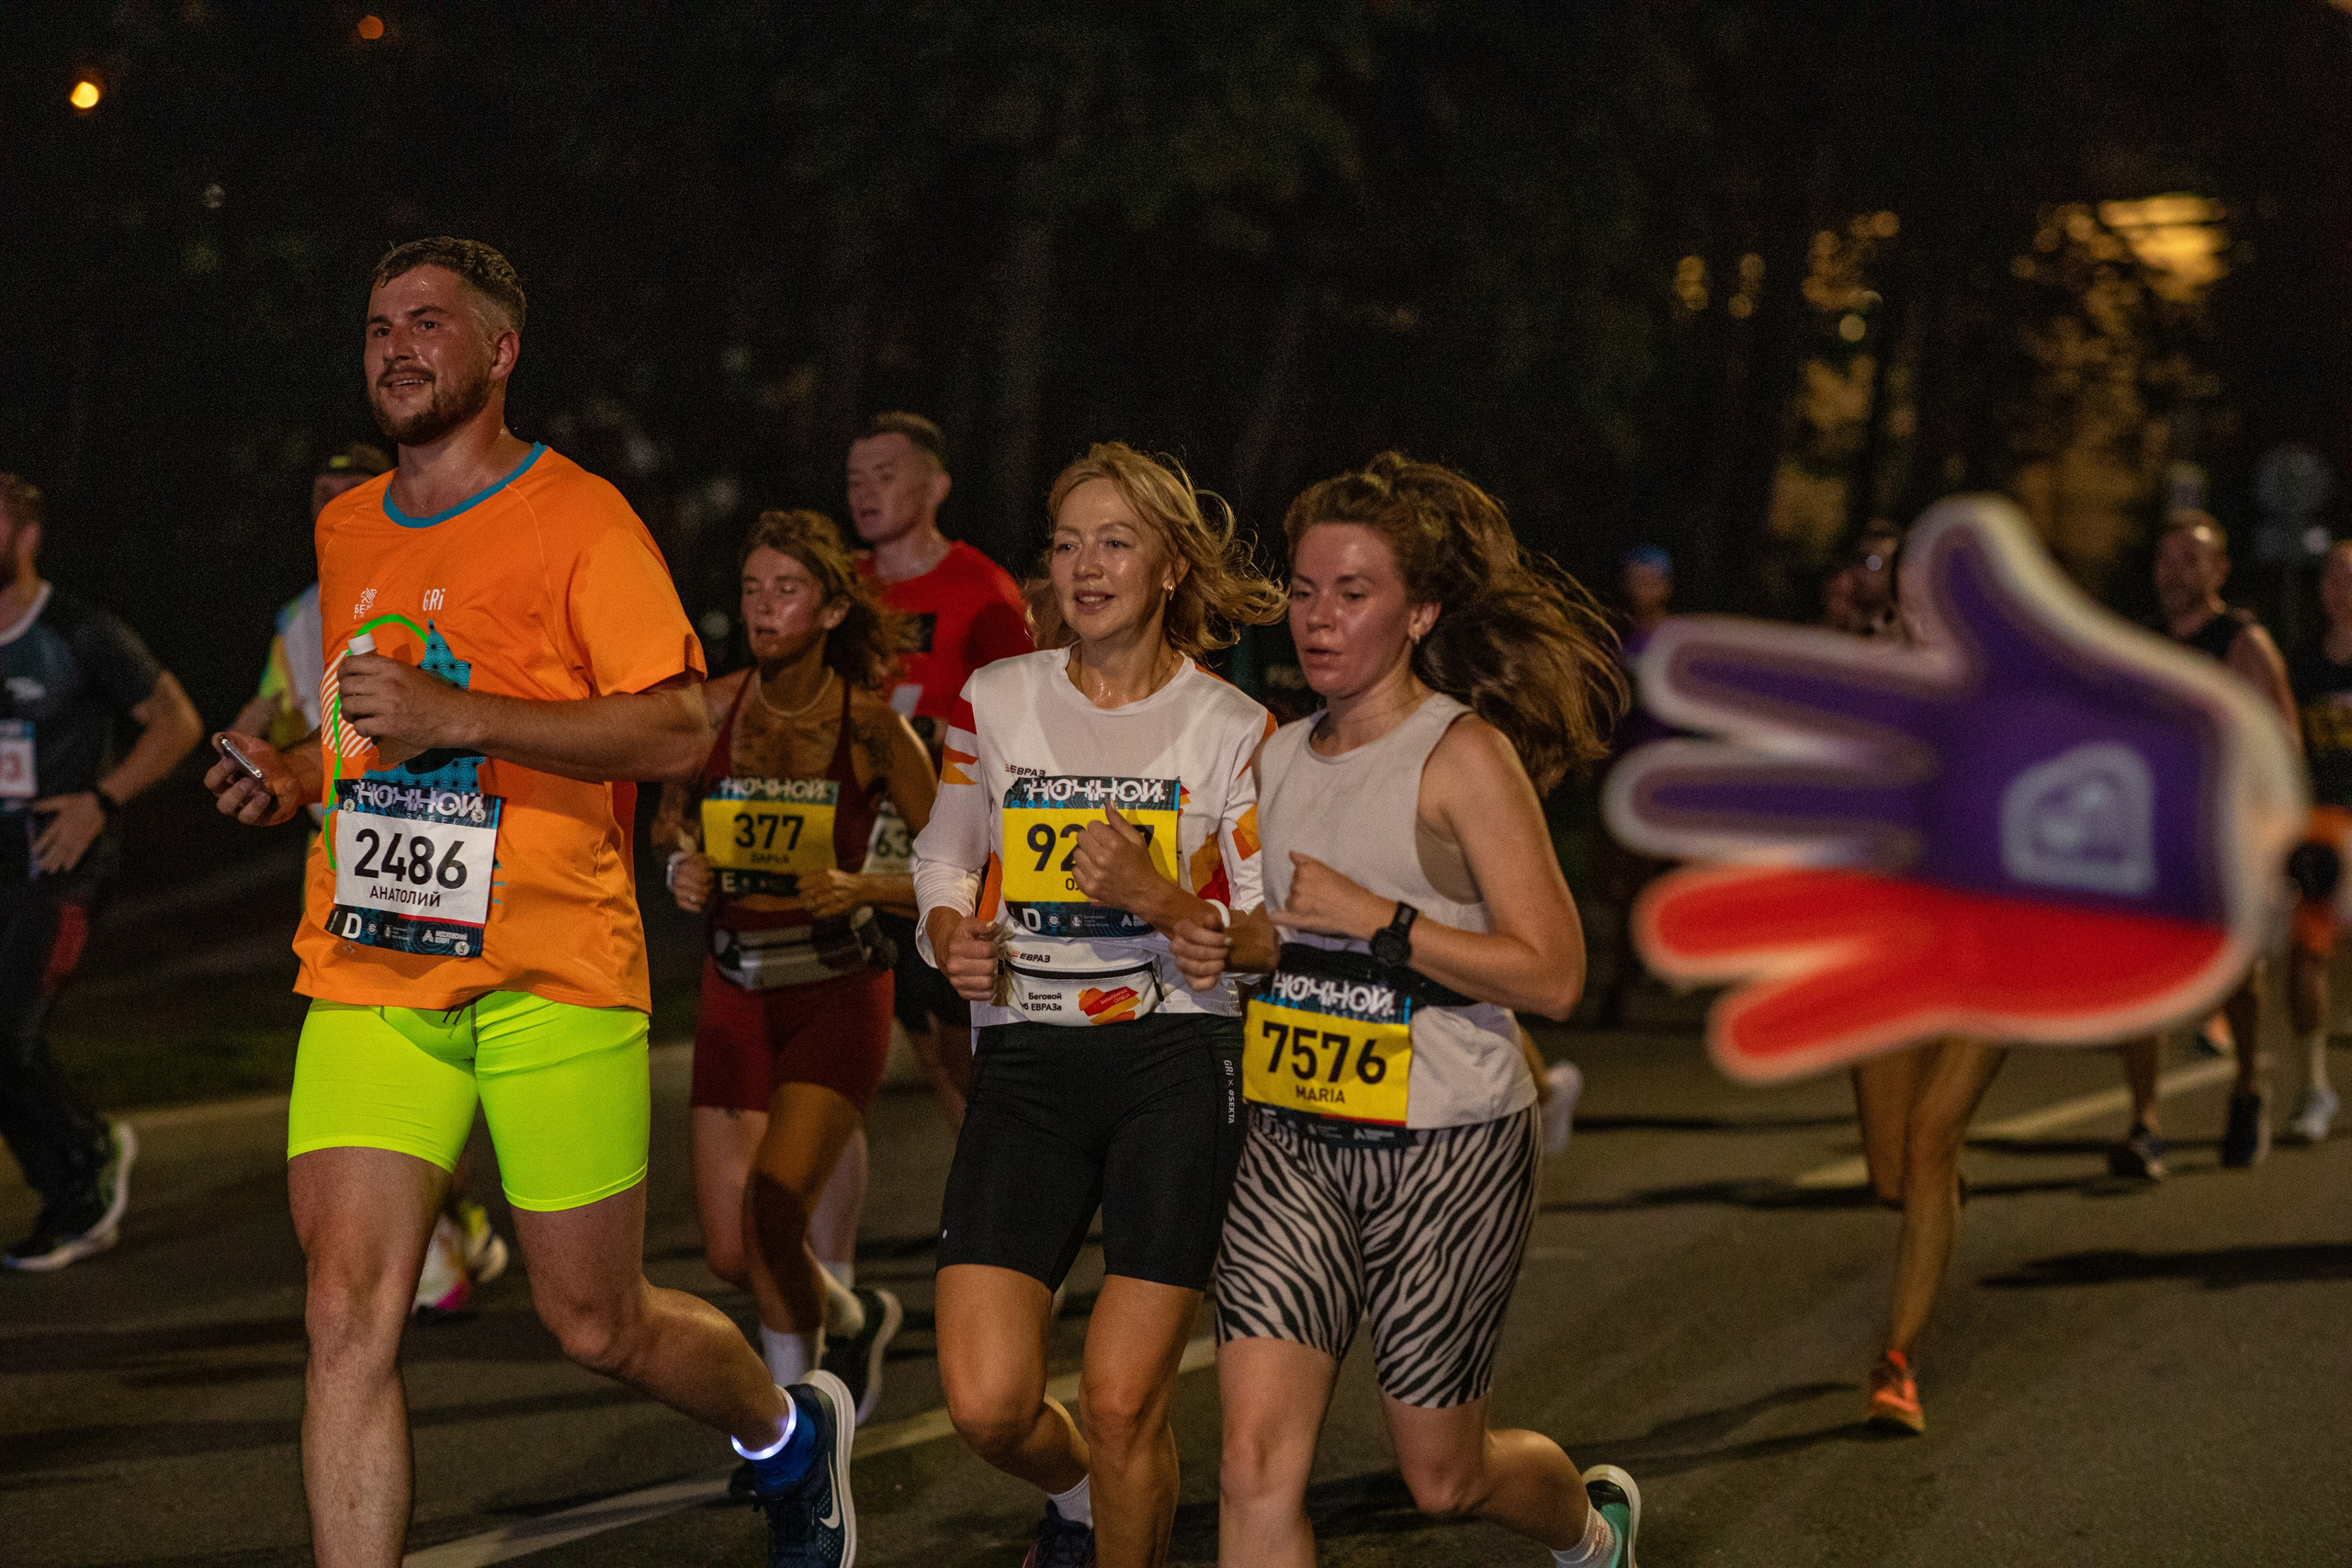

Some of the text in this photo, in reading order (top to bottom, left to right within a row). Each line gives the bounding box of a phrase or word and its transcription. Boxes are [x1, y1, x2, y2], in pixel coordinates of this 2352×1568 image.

[353, 780, 484, 818] НОЧНОЙ
[1023, 777, 1166, 803] НОЧНОЙ
[734, 813, 804, 851] 377
[354, 828, 468, 889] 2486
[721, 874, 735, 893] E
[369, 885, 441, 908] АНАТОЛИЙ
[341, 912, 362, 939] D
[1023, 908, 1041, 931] D
[1019, 953, 1050, 963] ЕВРАЗ
[1028, 992, 1062, 1000] Беговой
[1271, 971, 1396, 1017] НОЧНОЙ
[1031, 1003, 1062, 1011] ЕВРАЗа
[1261, 1021, 1386, 1084] 7576
[1295, 1085, 1345, 1104] MARIA
